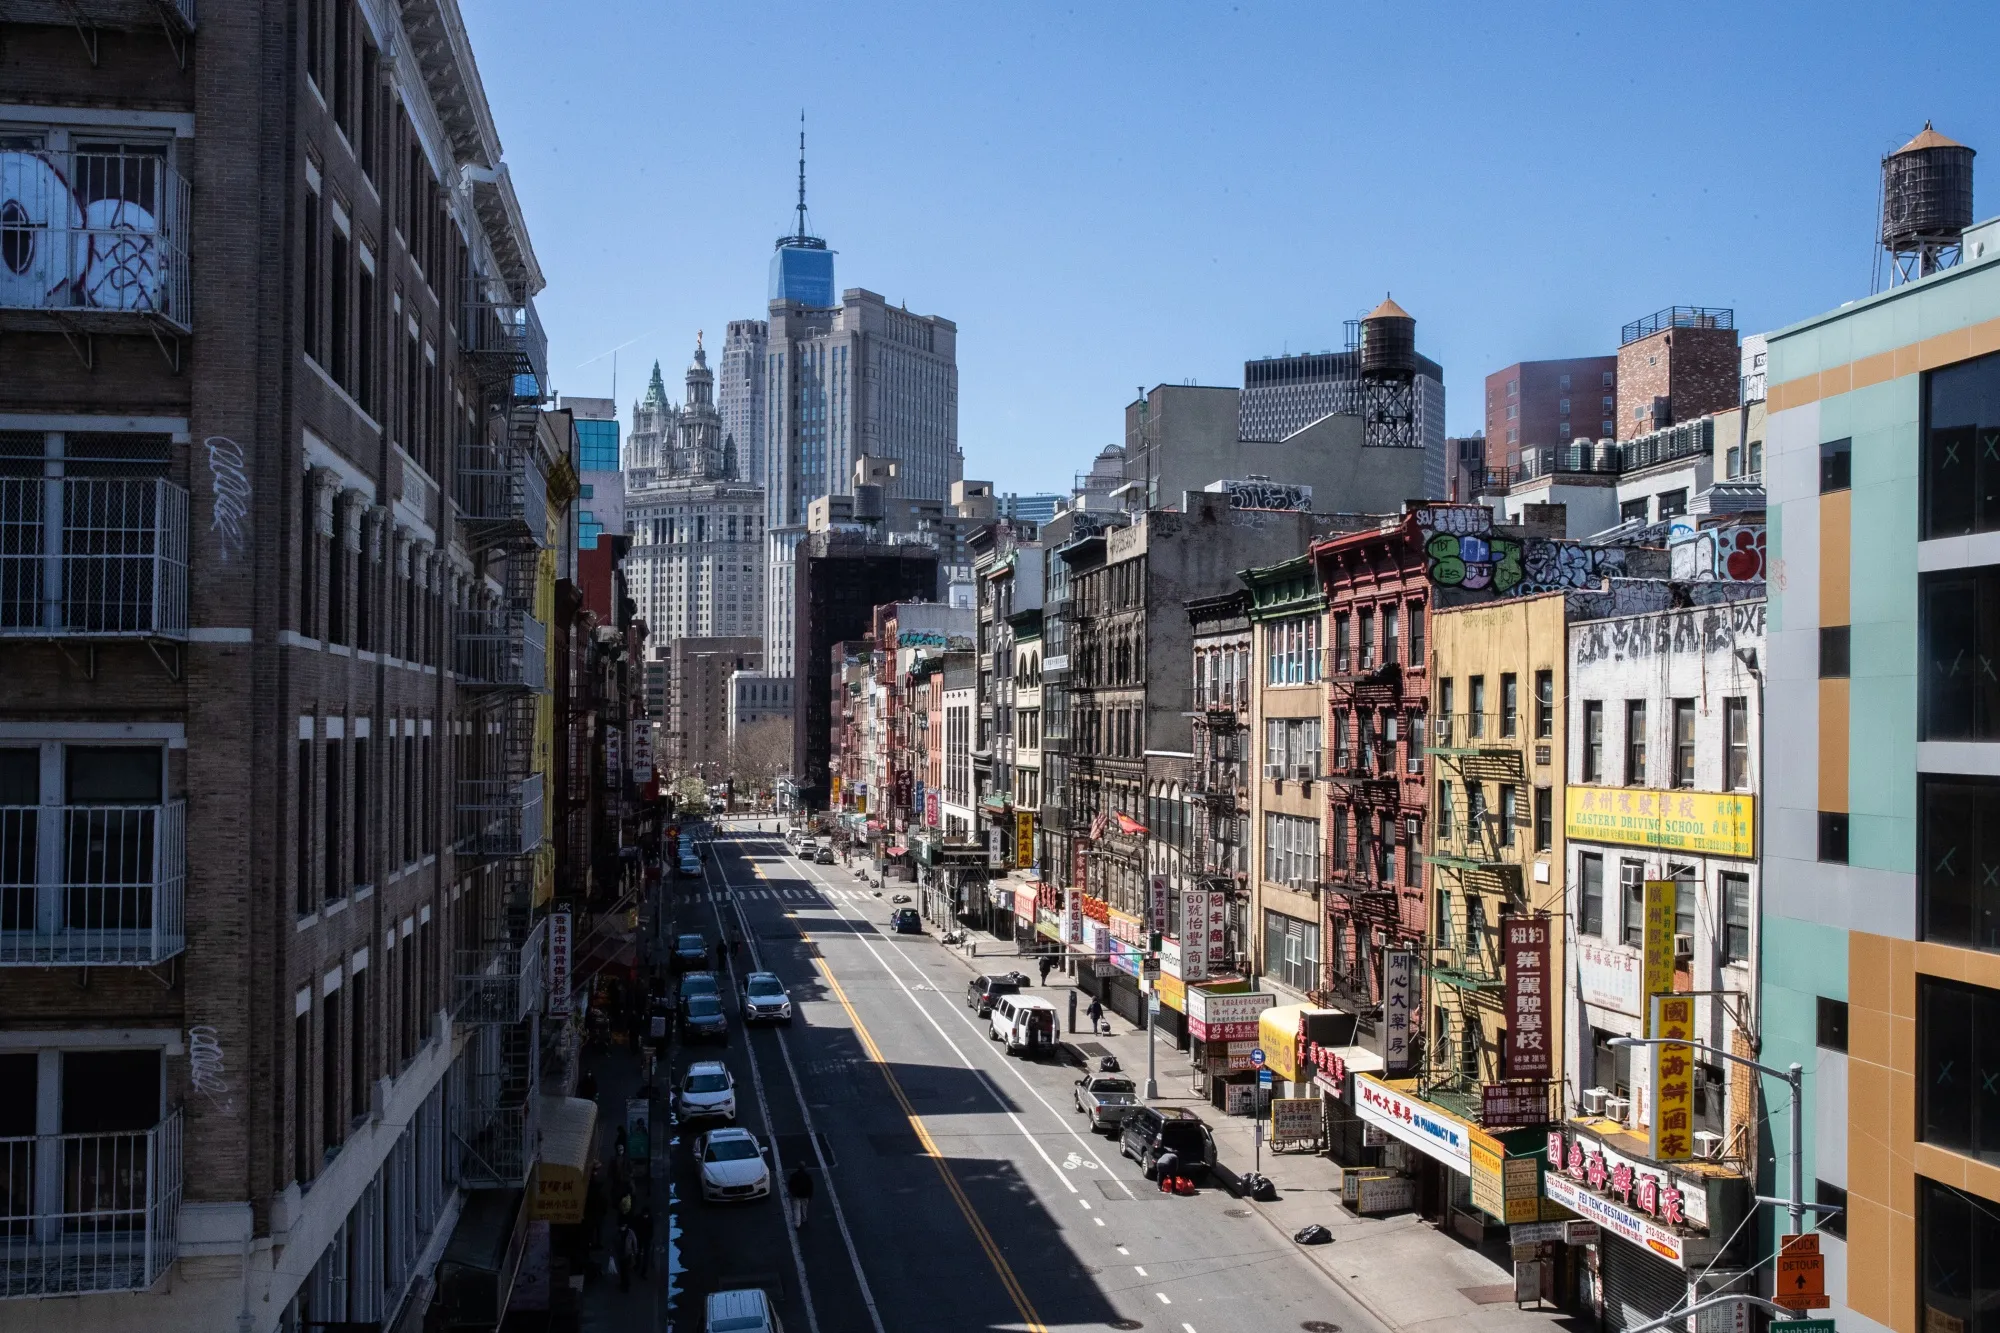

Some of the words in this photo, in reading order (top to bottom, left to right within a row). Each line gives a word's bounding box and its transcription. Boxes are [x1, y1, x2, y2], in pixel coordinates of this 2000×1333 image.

[1576, 813, 1616, 827] EASTERN
[1621, 816, 1660, 831] DRIVING
[1666, 820, 1705, 835] SCHOOL
[1511, 927, 1544, 943] 紐約
[1388, 955, 1408, 1054] 開心大藥房
[1516, 951, 1543, 1050] 第一駕駛學校
[1420, 1115, 1449, 1143] PHARMACY
[1578, 1191, 1587, 1204] FEI
[1603, 1204, 1641, 1232] RESTAURANT
[1784, 1239, 1816, 1251] TRUCK
[1782, 1259, 1819, 1272] DETOUR
